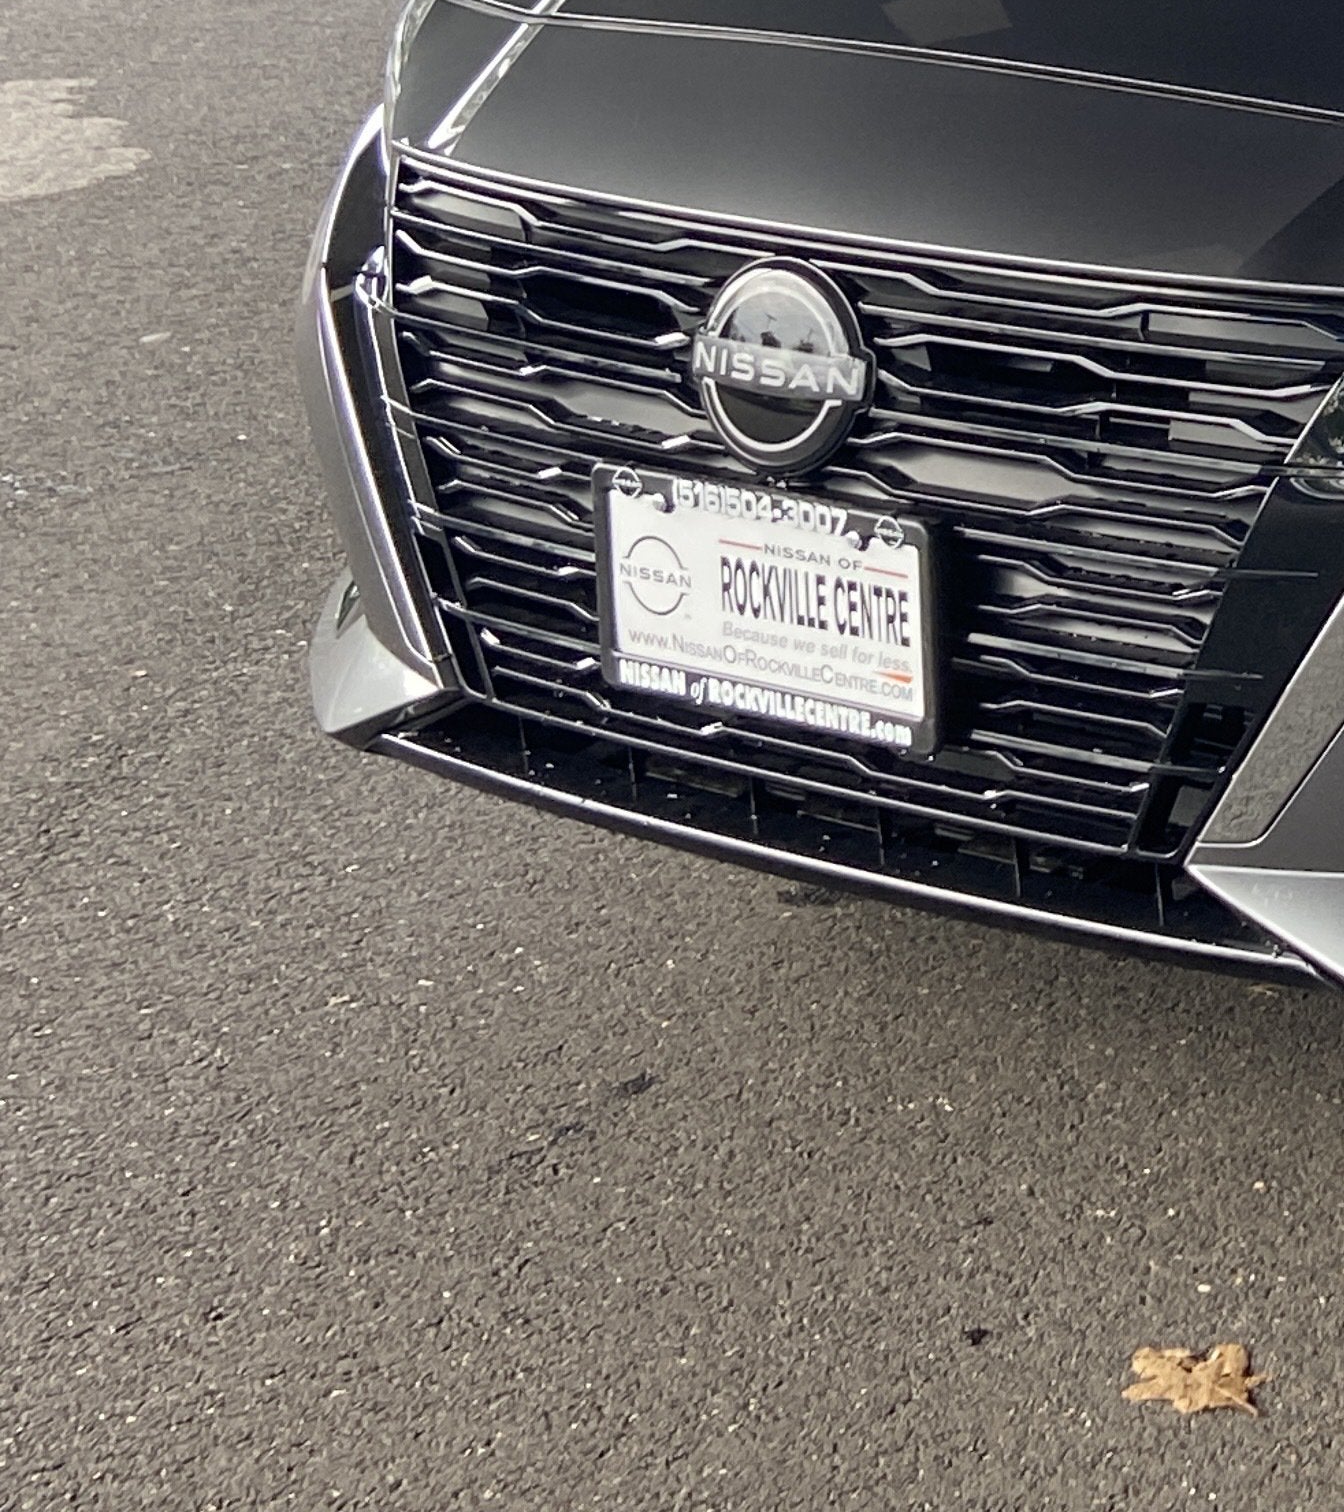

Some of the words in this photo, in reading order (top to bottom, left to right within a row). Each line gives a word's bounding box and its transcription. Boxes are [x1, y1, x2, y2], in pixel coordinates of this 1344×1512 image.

[695, 341, 861, 396] NISSAN
[619, 562, 692, 588] NISSAN
[764, 544, 830, 566] NISSAN
[838, 557, 863, 571] OF
[721, 555, 828, 630] ROCKVILLE
[833, 575, 911, 647] CENTRE
[723, 621, 788, 648] Because
[794, 639, 816, 654] we
[820, 641, 848, 660] sell
[852, 646, 874, 664] for
[619, 658, 686, 696] NISSAN
[690, 677, 707, 705] of
